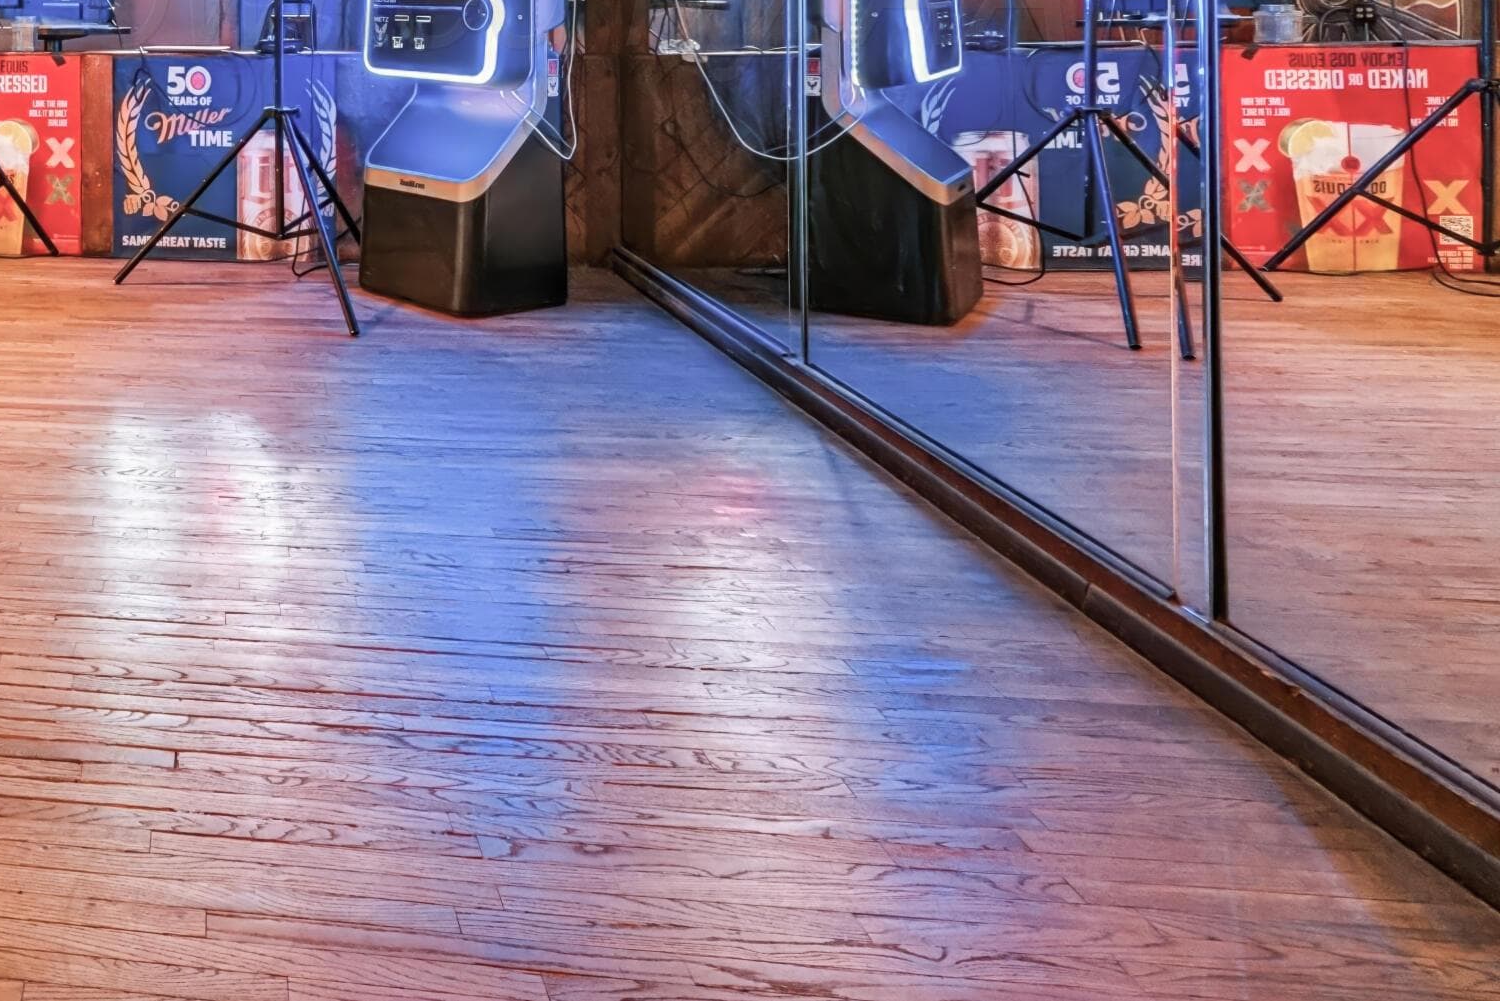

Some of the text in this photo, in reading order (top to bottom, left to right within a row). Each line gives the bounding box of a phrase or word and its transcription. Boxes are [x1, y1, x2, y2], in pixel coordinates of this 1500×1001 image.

[167, 65, 212, 96] 50
[168, 96, 213, 106] YEARS OF
[145, 107, 233, 144] Miller
[188, 130, 234, 147] TIME
[192, 236, 227, 249] TASTE
